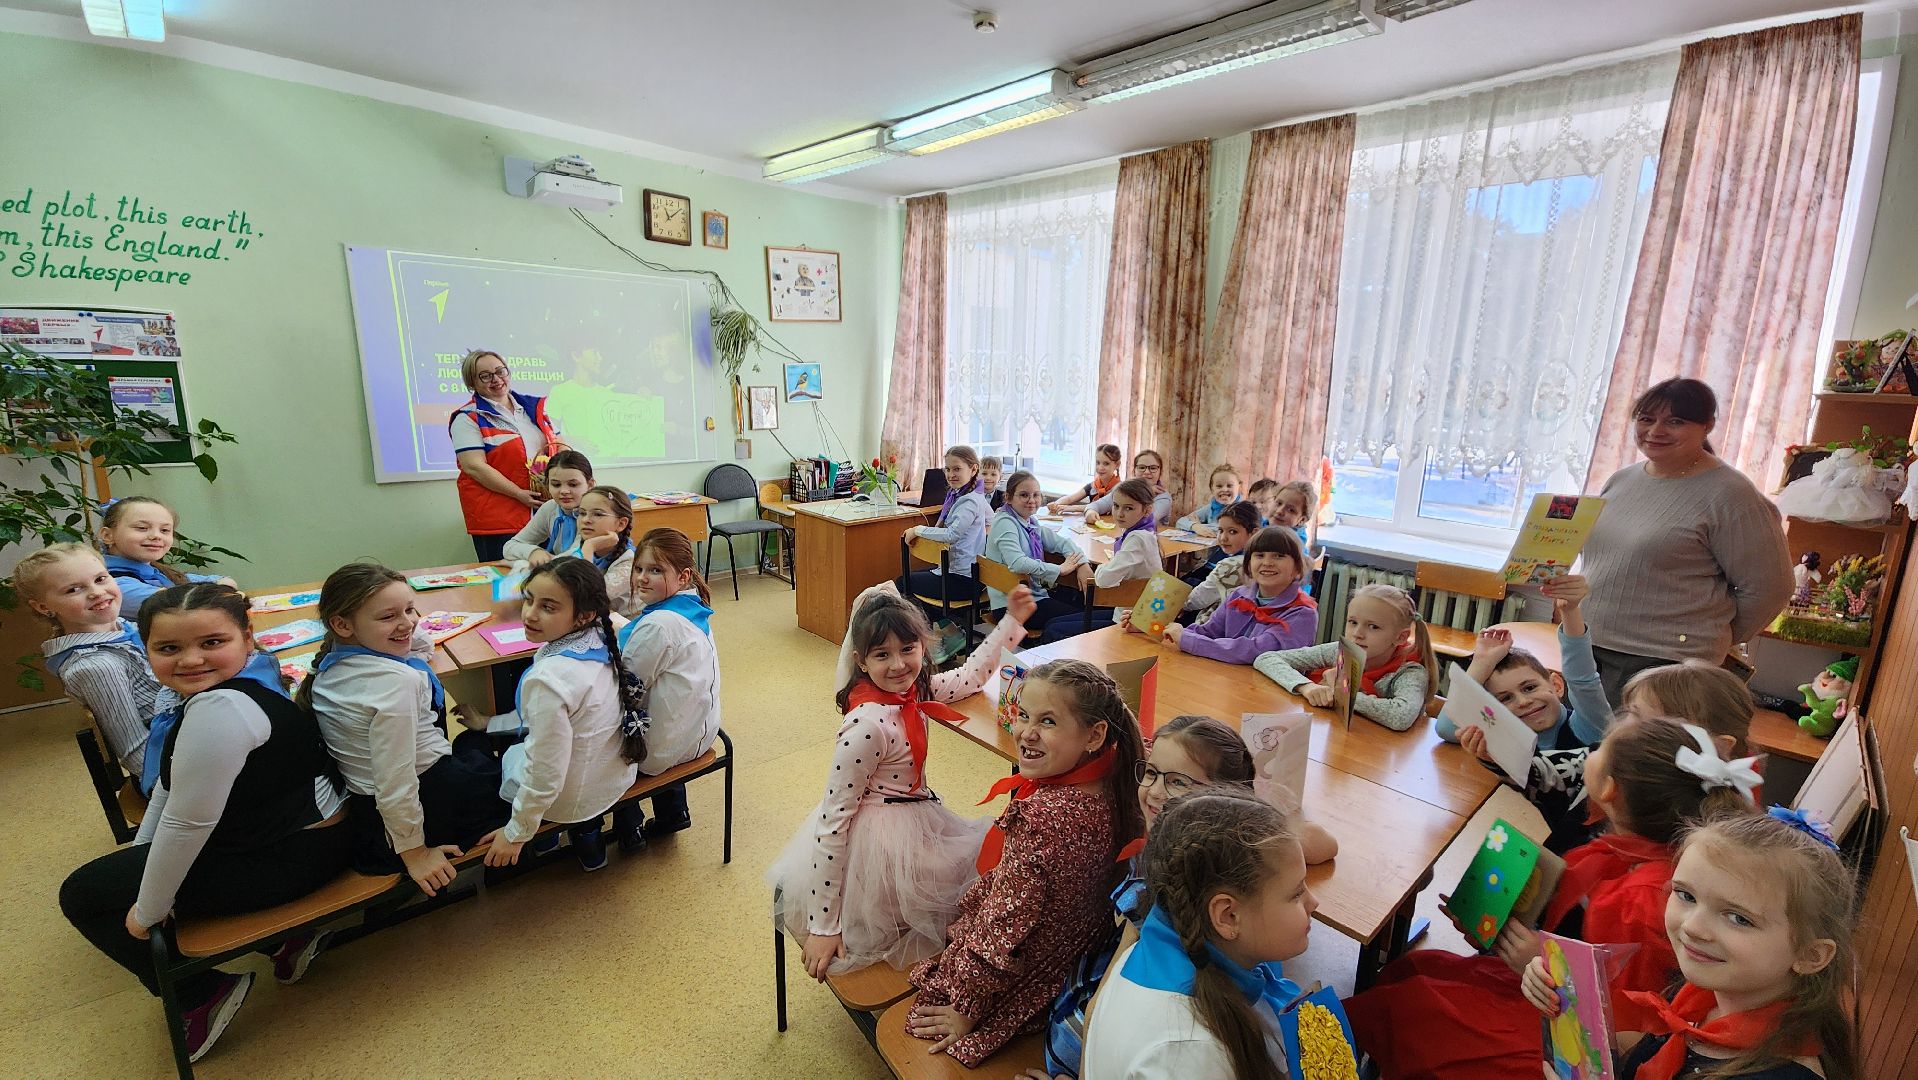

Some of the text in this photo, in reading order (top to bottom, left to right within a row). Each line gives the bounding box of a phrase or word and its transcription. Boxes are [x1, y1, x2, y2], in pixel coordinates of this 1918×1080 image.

[1, 187, 33, 213] ed
[117, 195, 168, 224] this
[41, 222, 94, 248] this
[12, 252, 191, 292] Shakespeare
[435, 353, 546, 368] ТЕП ДРАВЬ
[511, 371, 564, 382] ЖЕНЩИН
[439, 383, 448, 392] С
[451, 383, 458, 393] 8
